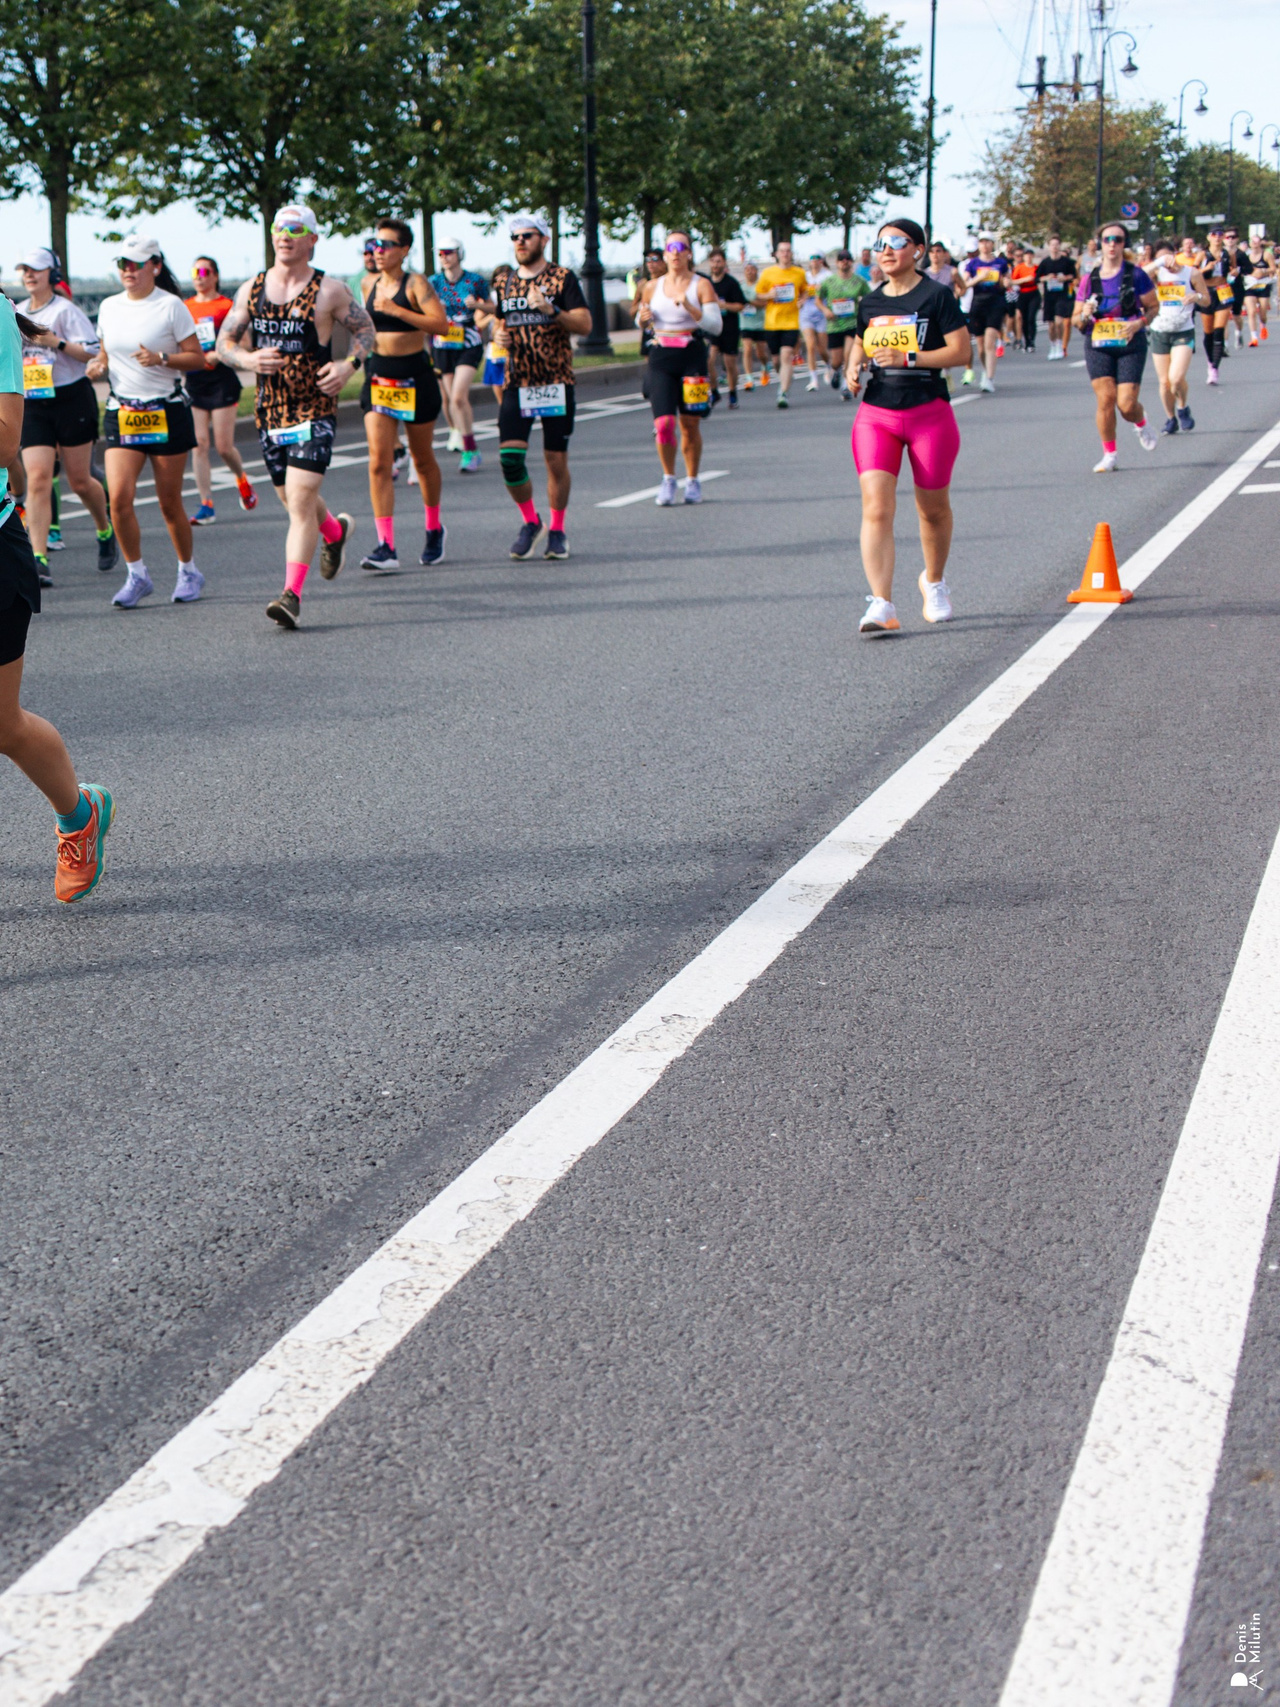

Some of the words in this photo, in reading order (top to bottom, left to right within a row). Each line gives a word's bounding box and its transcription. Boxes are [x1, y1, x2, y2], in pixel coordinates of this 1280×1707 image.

[254, 318, 305, 335] BEDRIK
[871, 330, 909, 347] 4635
[378, 390, 409, 403] 2453
[527, 386, 559, 401] 2542
[126, 414, 160, 427] 4002
